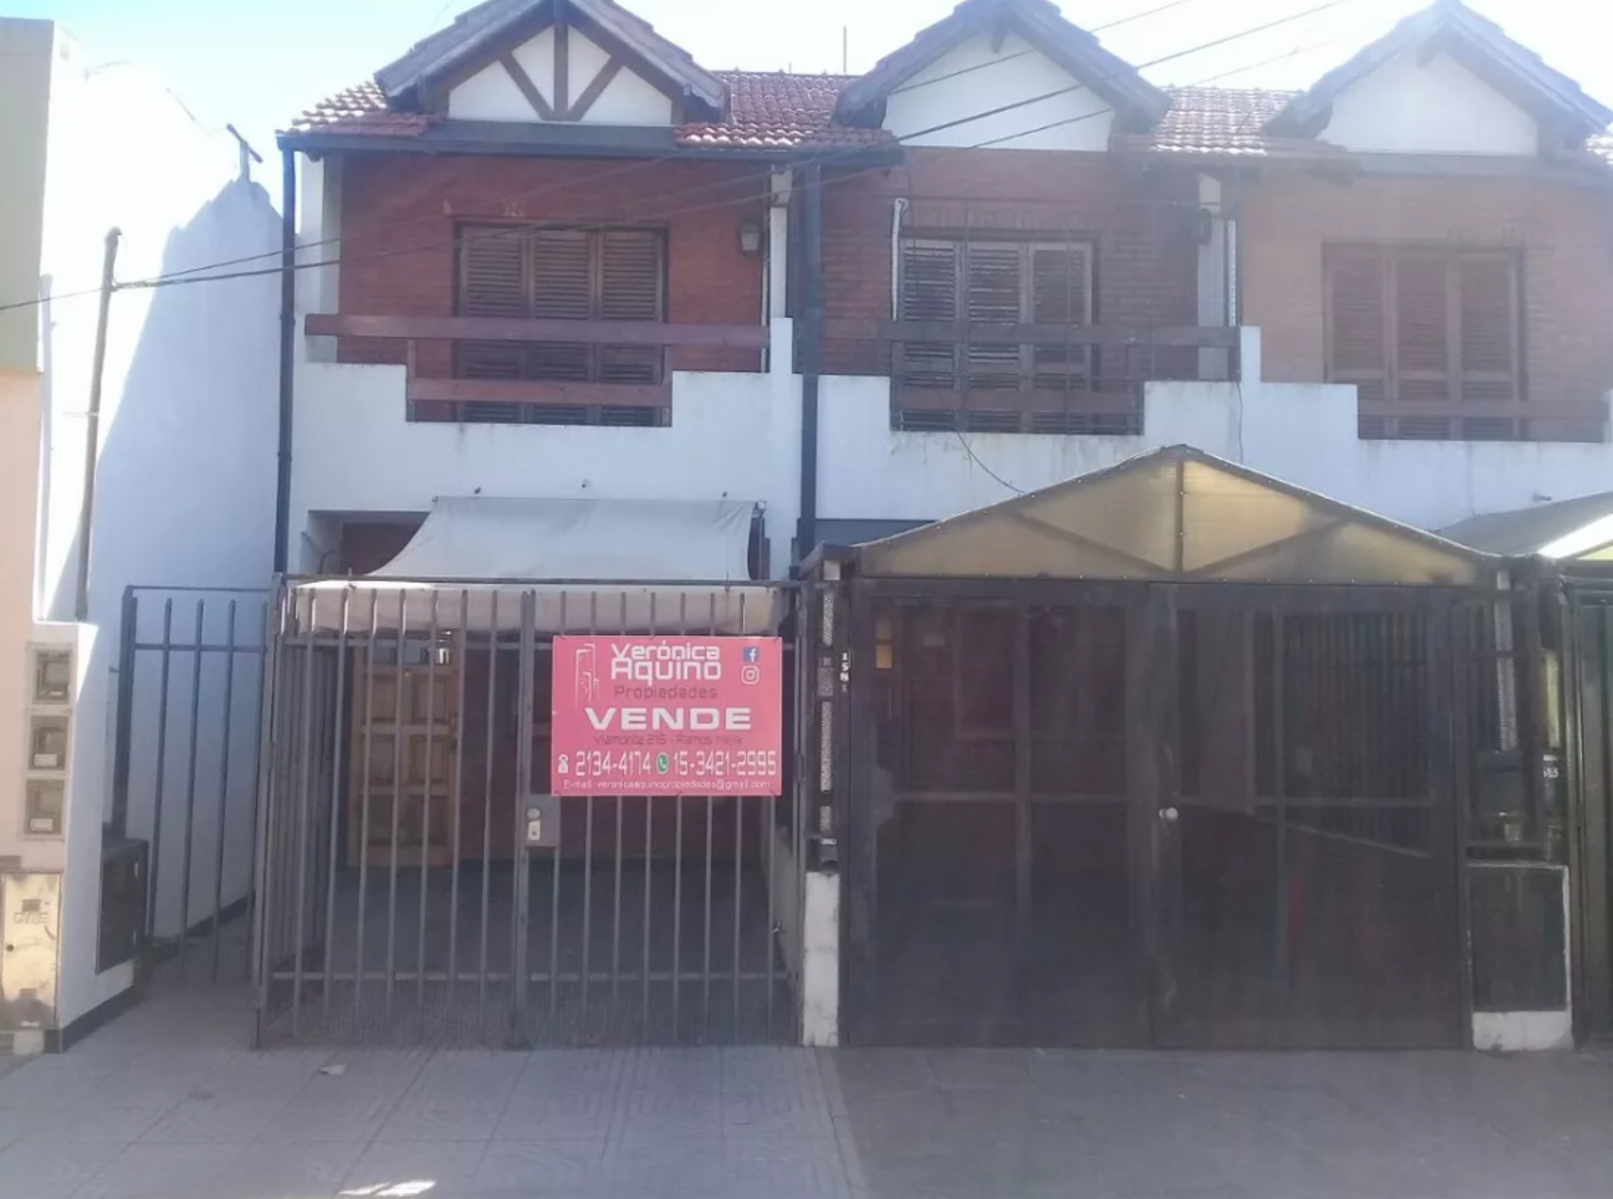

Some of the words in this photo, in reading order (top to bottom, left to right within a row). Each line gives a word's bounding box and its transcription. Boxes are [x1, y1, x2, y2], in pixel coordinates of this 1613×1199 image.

[611, 640, 720, 660] Verónica
[611, 657, 722, 686] Aquino
[614, 685, 718, 700] Propiedades
[584, 707, 752, 731] VENDE
[576, 751, 651, 776] 2134-4174
